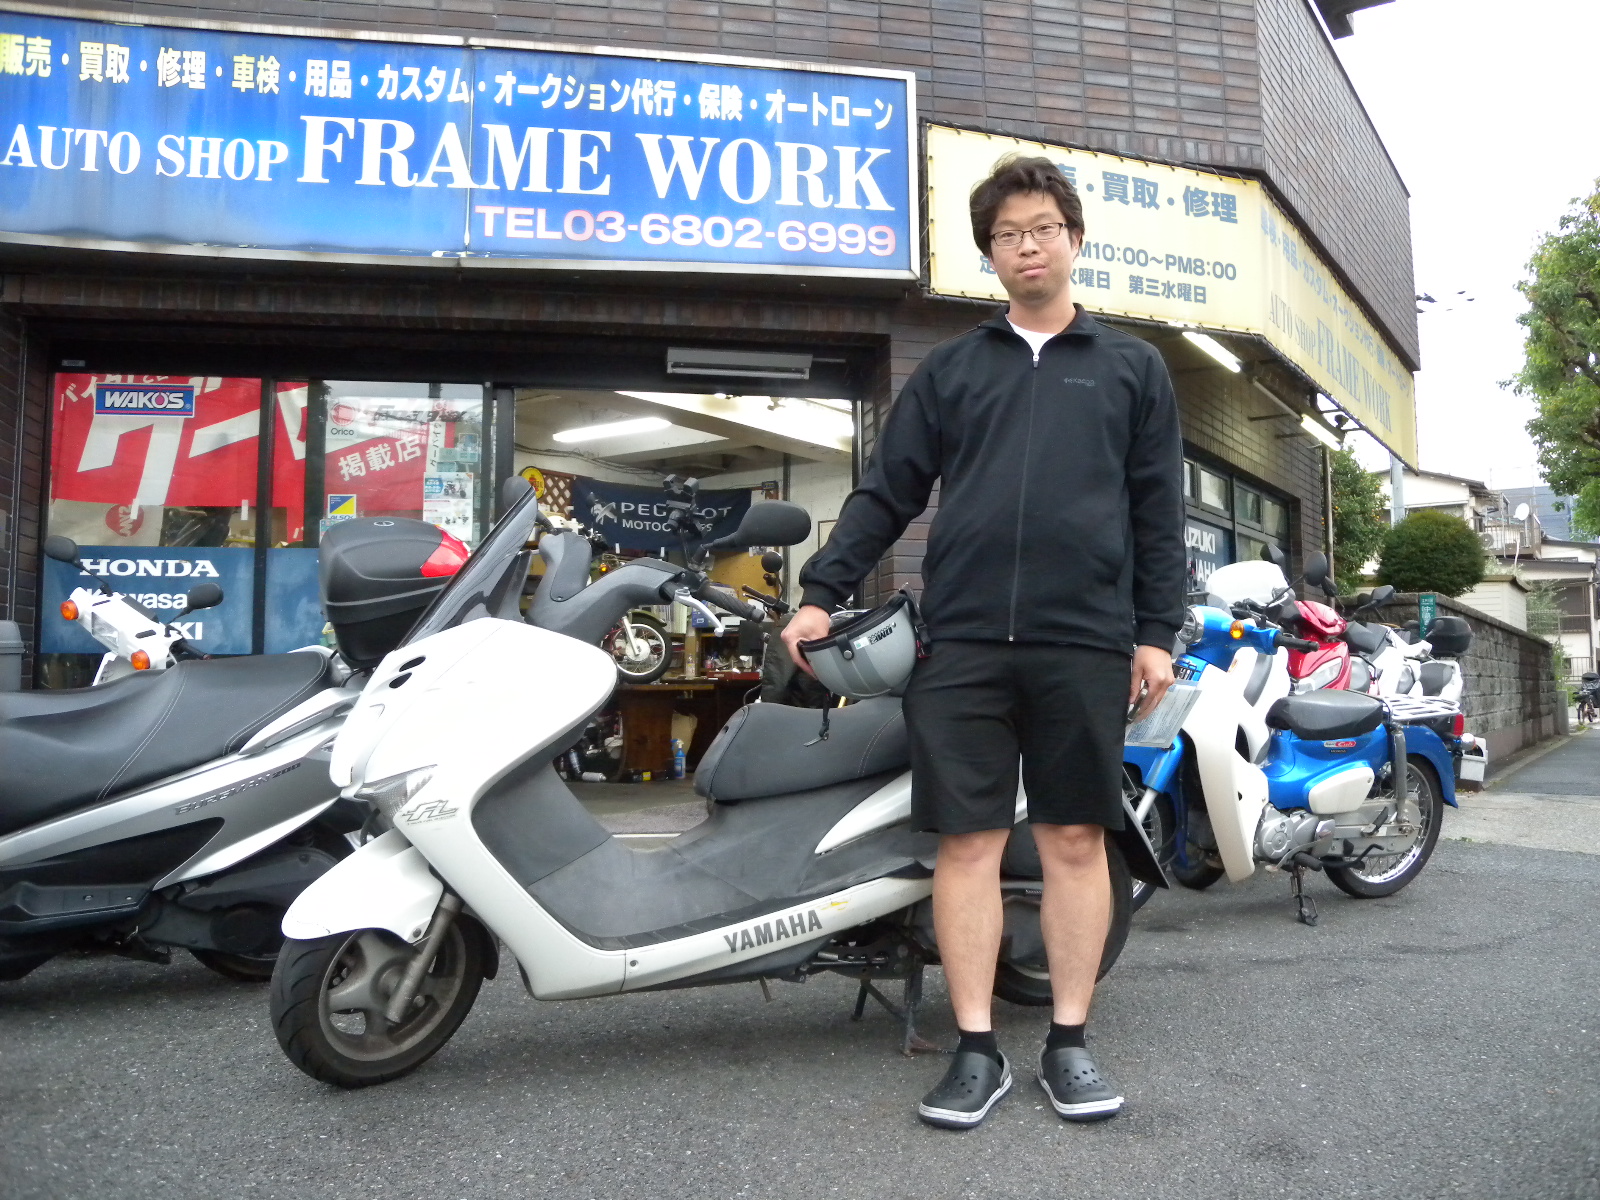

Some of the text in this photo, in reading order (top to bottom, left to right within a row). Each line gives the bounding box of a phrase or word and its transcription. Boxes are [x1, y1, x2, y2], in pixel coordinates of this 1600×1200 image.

[2, 115, 895, 211] AUTO SHOP FRAME WORK
[1128, 273, 1208, 305] 第三水曜日
[1317, 317, 1361, 402] FRAME
[1362, 366, 1392, 433] WORK
[330, 427, 355, 436] Orico
[338, 435, 422, 481] 掲載店
[1184, 525, 1216, 555] UZUKI
[79, 558, 220, 578] HONDA
[723, 909, 823, 954] YAMAHA
